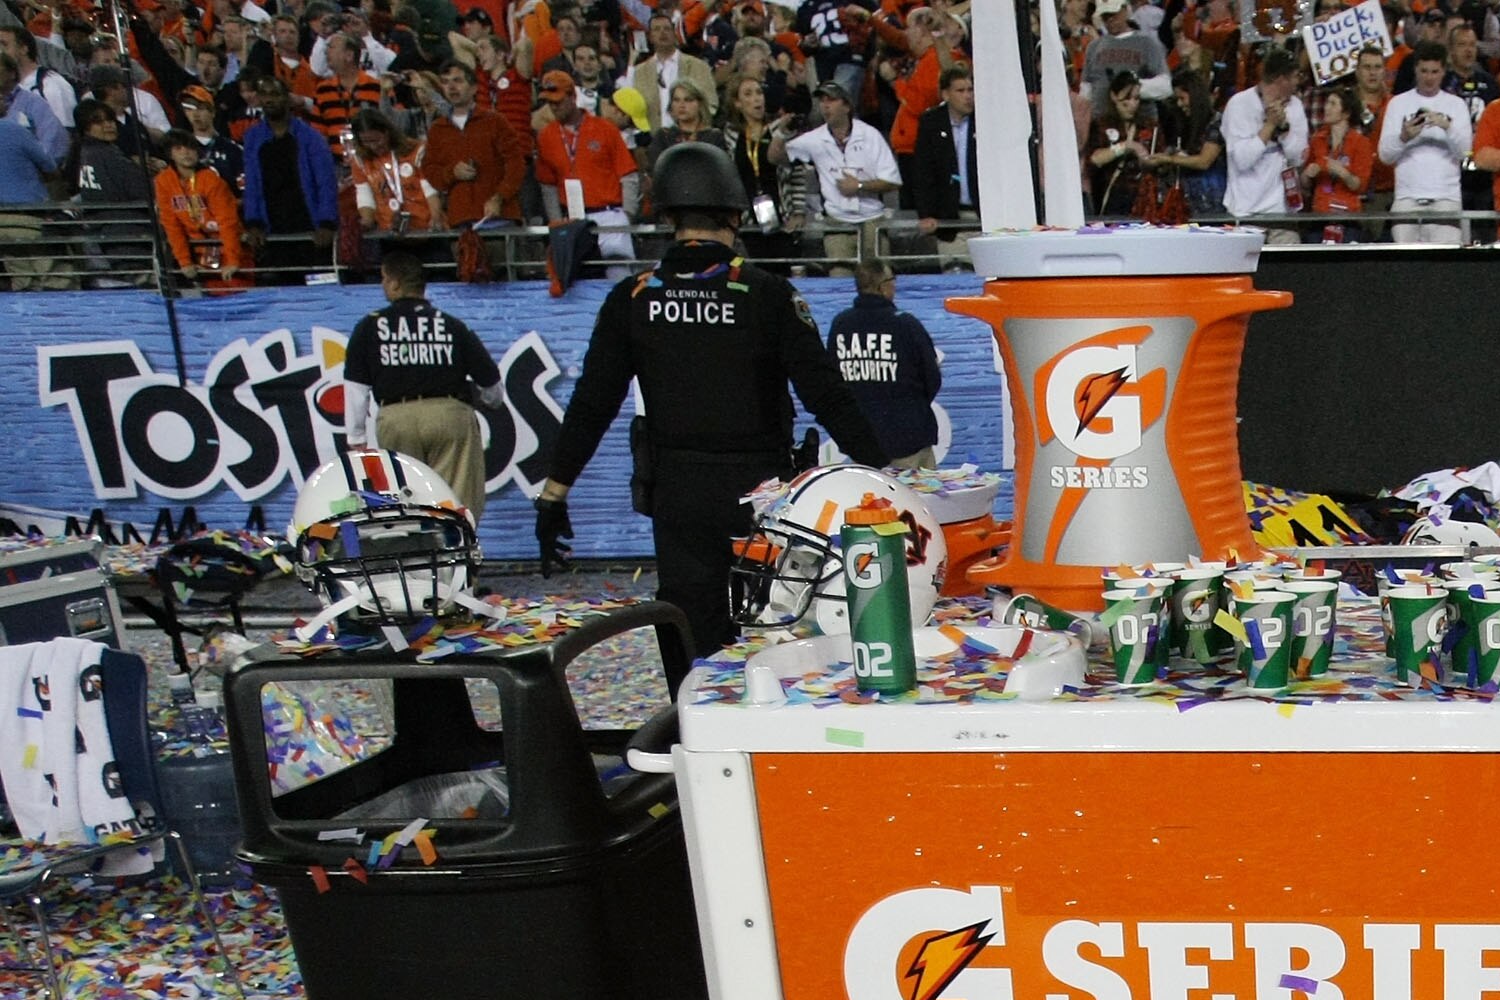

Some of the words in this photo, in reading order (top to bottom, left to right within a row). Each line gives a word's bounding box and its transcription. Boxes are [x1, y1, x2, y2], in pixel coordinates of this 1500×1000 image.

[1312, 7, 1375, 42] Duck,
[1314, 37, 1385, 81] LOS!
[665, 289, 718, 300] GLENDALE
[648, 301, 736, 325] POLICE
[379, 343, 454, 366] SECURITY
[836, 332, 898, 361] S.A.F.E.
[839, 360, 899, 382] SECURITY
[1046, 344, 1142, 460] G
[1049, 465, 1149, 489] SERIES
[845, 543, 881, 589] G
[851, 641, 896, 678] 02
